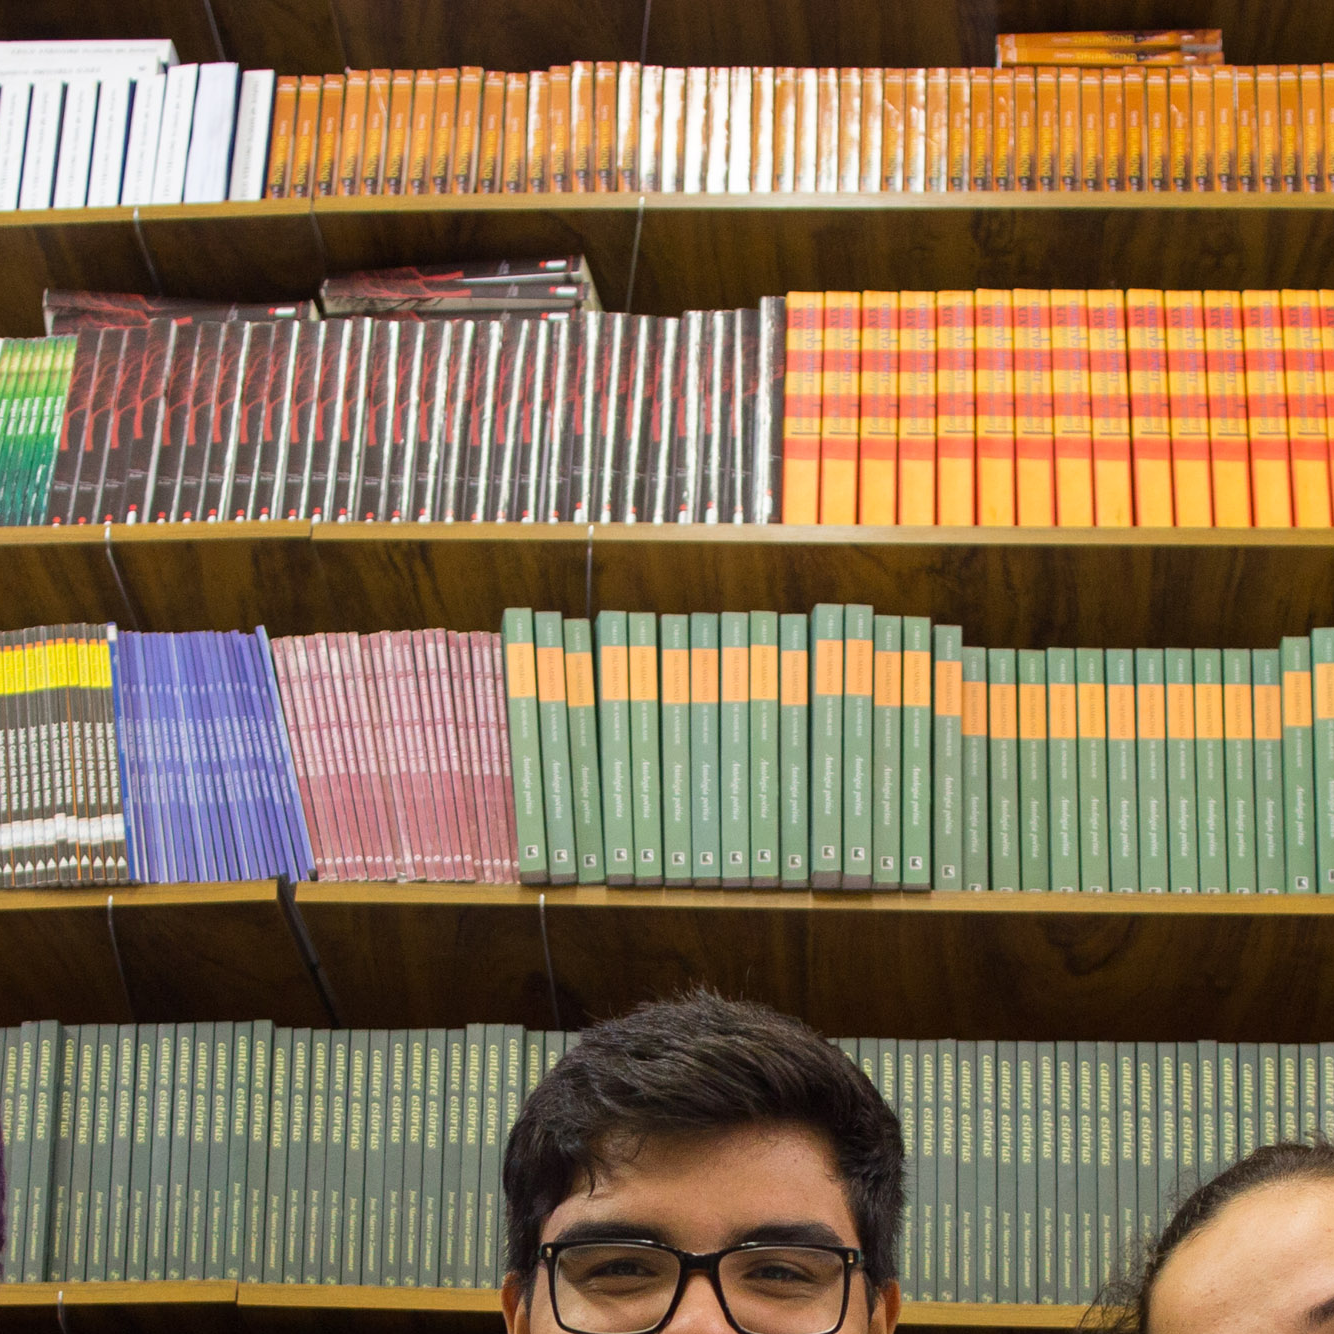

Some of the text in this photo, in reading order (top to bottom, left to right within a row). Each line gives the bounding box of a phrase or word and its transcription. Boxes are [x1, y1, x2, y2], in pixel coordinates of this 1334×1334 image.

[853, 755, 863, 815] Antologia poética
[911, 765, 921, 825] Antologia poética
[36, 1040, 52, 1140] cantare estórias
[137, 1044, 151, 1143] cantare estórias
[427, 1048, 439, 1149] cantare estórias
[487, 1045, 498, 1145] cantare estórias
